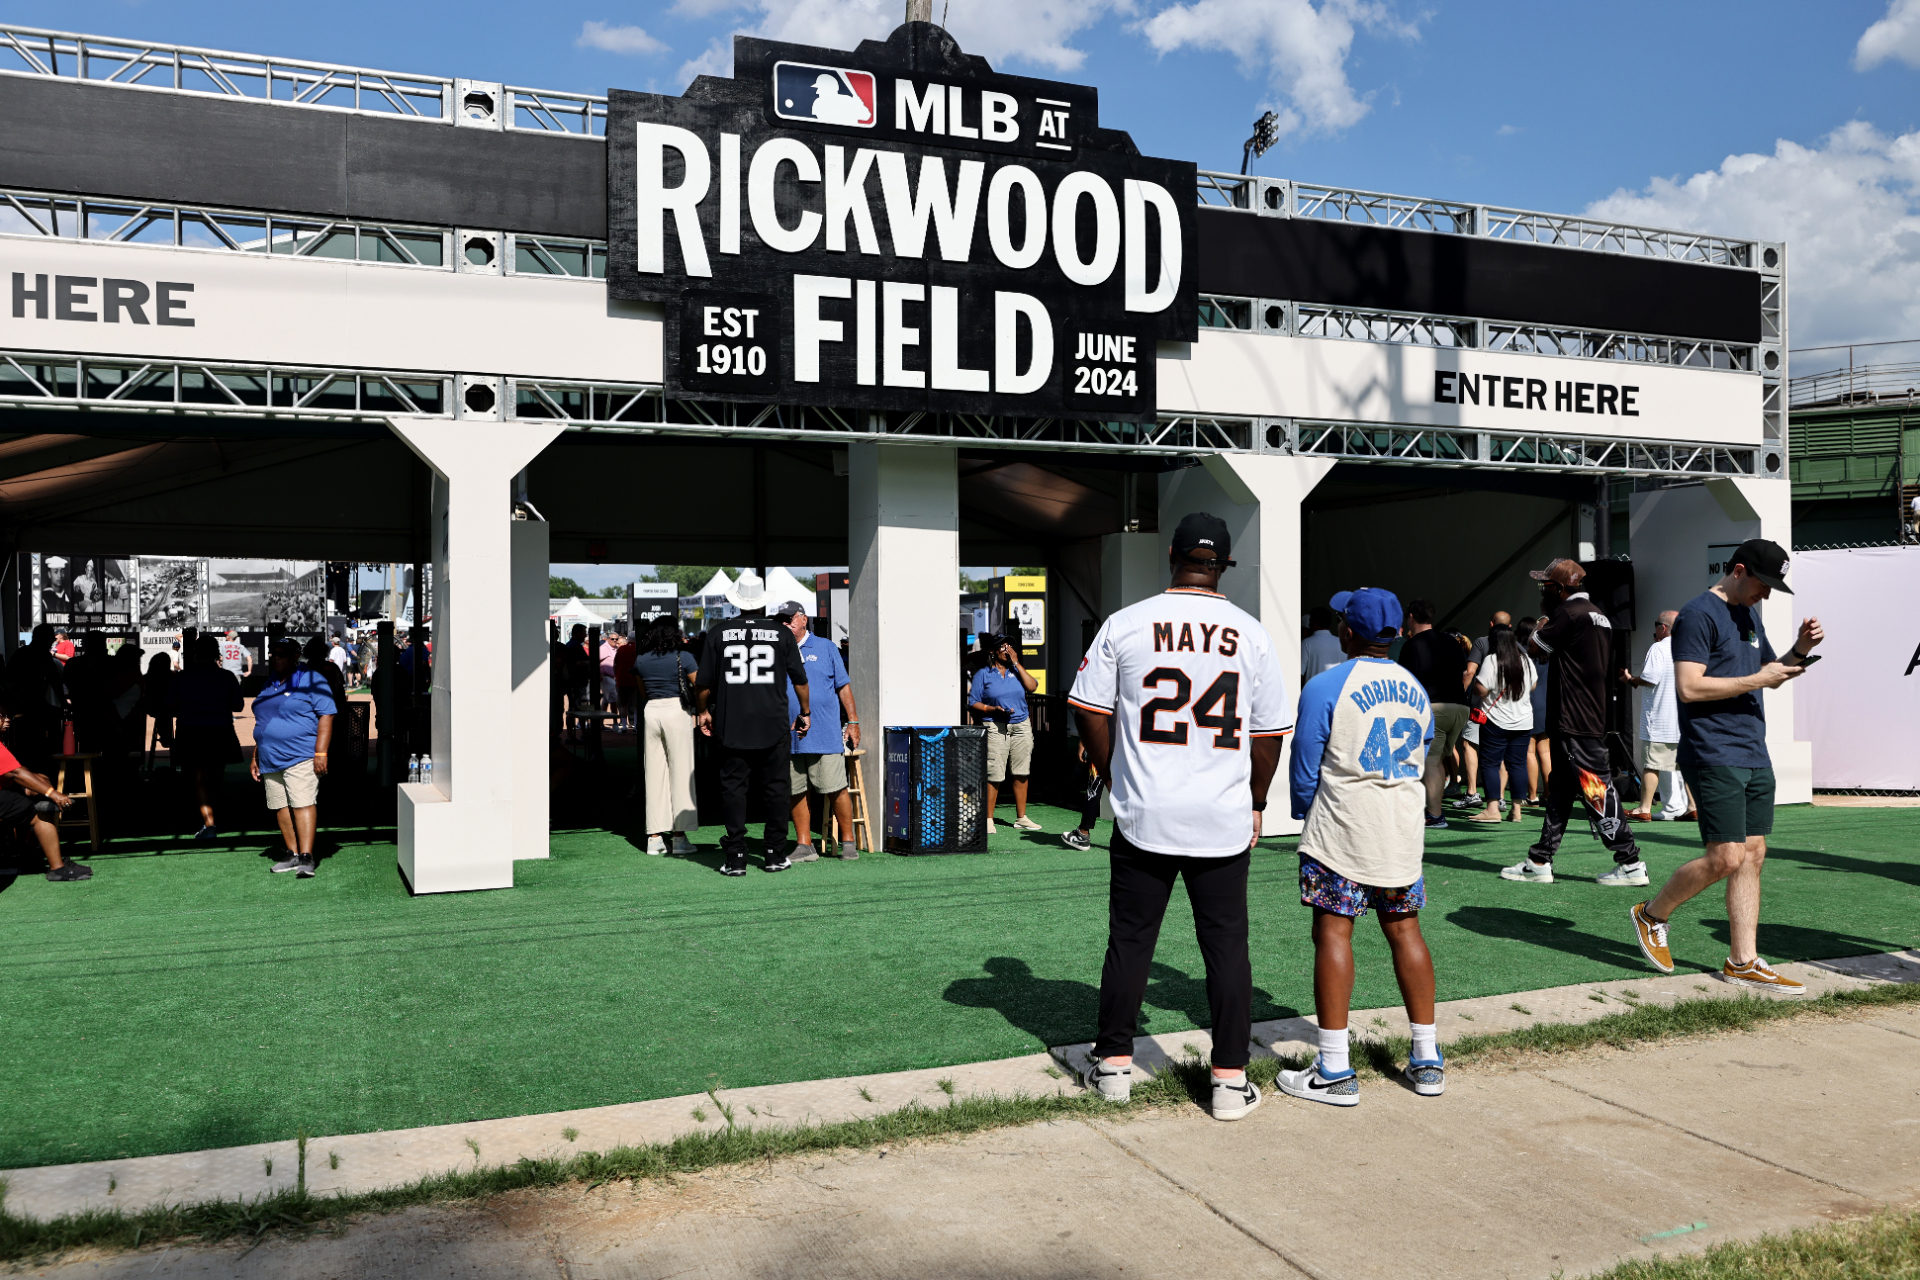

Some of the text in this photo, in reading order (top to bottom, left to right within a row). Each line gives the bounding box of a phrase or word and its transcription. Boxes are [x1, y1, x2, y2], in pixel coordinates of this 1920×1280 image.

[895, 79, 1070, 142] MLB AT
[636, 121, 1183, 314] RICKWOOD
[12, 272, 196, 327] HERE
[703, 306, 760, 339] EST
[793, 273, 1055, 395] FIELD
[696, 343, 767, 377] 1910
[1074, 332, 1137, 364] JUNE
[1074, 366, 1139, 397] 2024
[1434, 370, 1640, 416] ENTER HERE
[1709, 562, 1720, 575] NO
[143, 636, 158, 645] BLACK
[722, 628, 748, 642] NEW
[1153, 621, 1241, 657] MAYS
[225, 649, 241, 661] 32
[723, 644, 775, 684] 32
[1140, 666, 1242, 750] 24
[1350, 678, 1426, 715] ROBINSON
[888, 752, 908, 763] RECYCLE
[1357, 716, 1423, 780] 42
